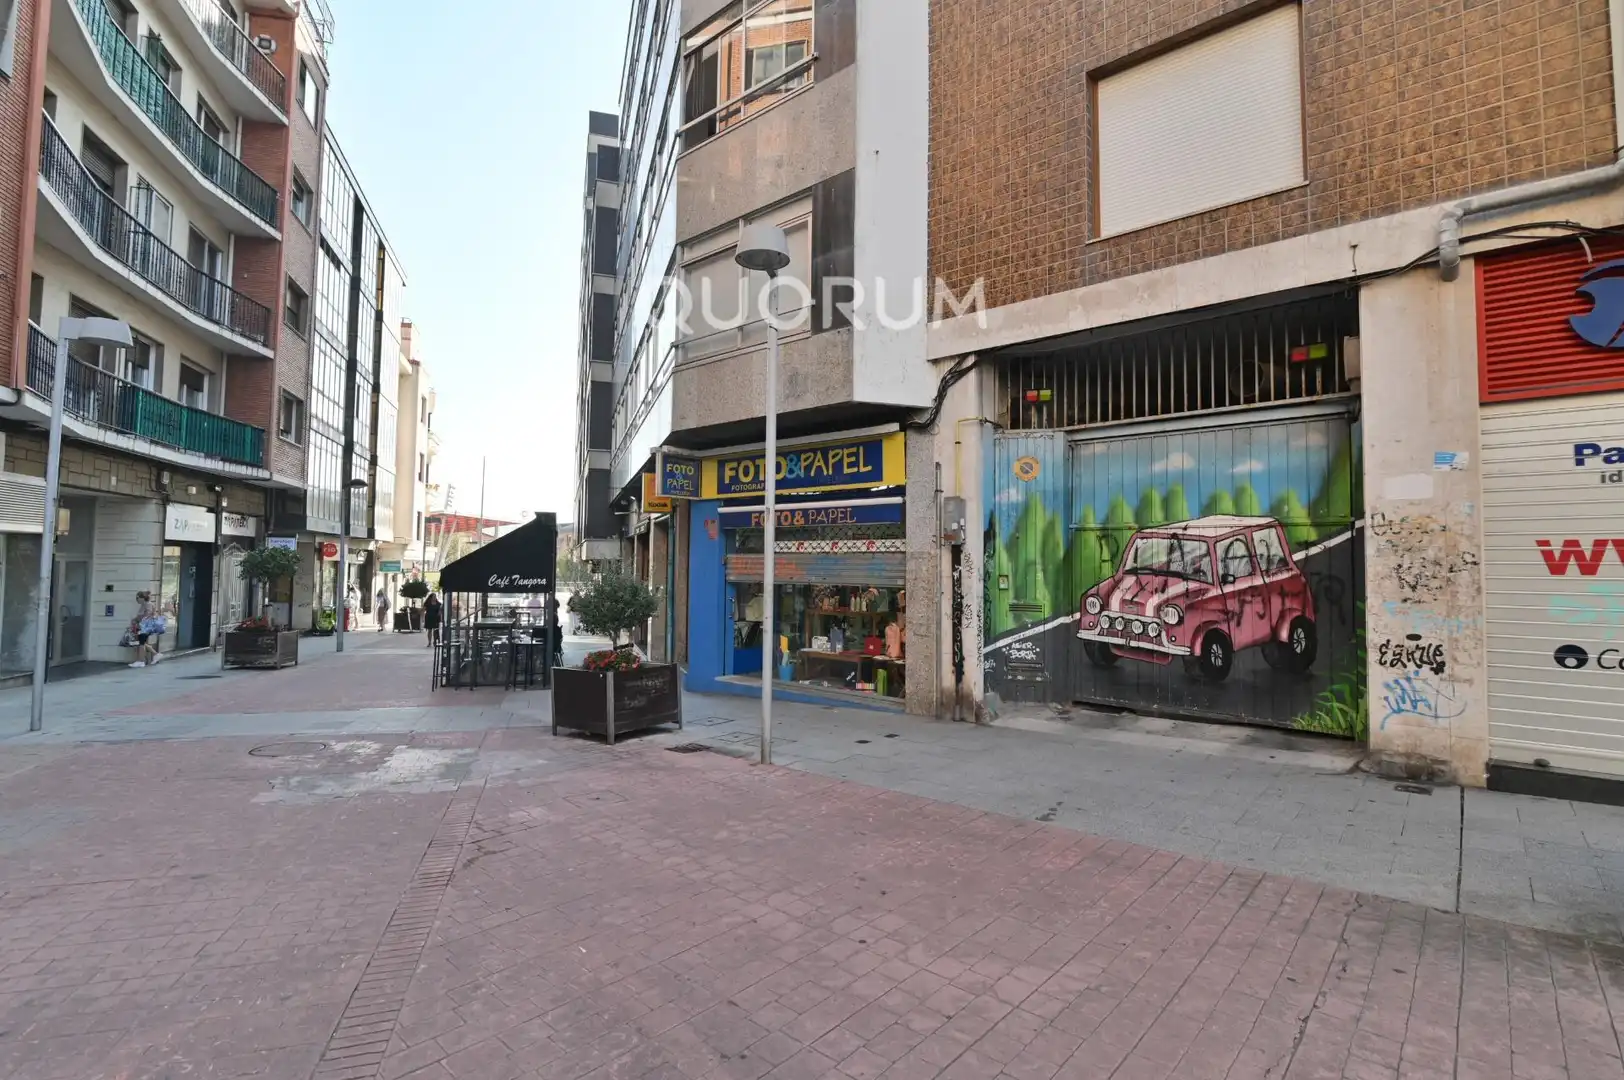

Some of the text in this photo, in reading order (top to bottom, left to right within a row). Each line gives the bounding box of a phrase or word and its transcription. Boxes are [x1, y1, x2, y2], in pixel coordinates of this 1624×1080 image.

[666, 464, 694, 475] FOTO
[667, 479, 694, 491] PAPEL
[808, 507, 857, 525] PAPEL
[488, 574, 510, 588] Café
